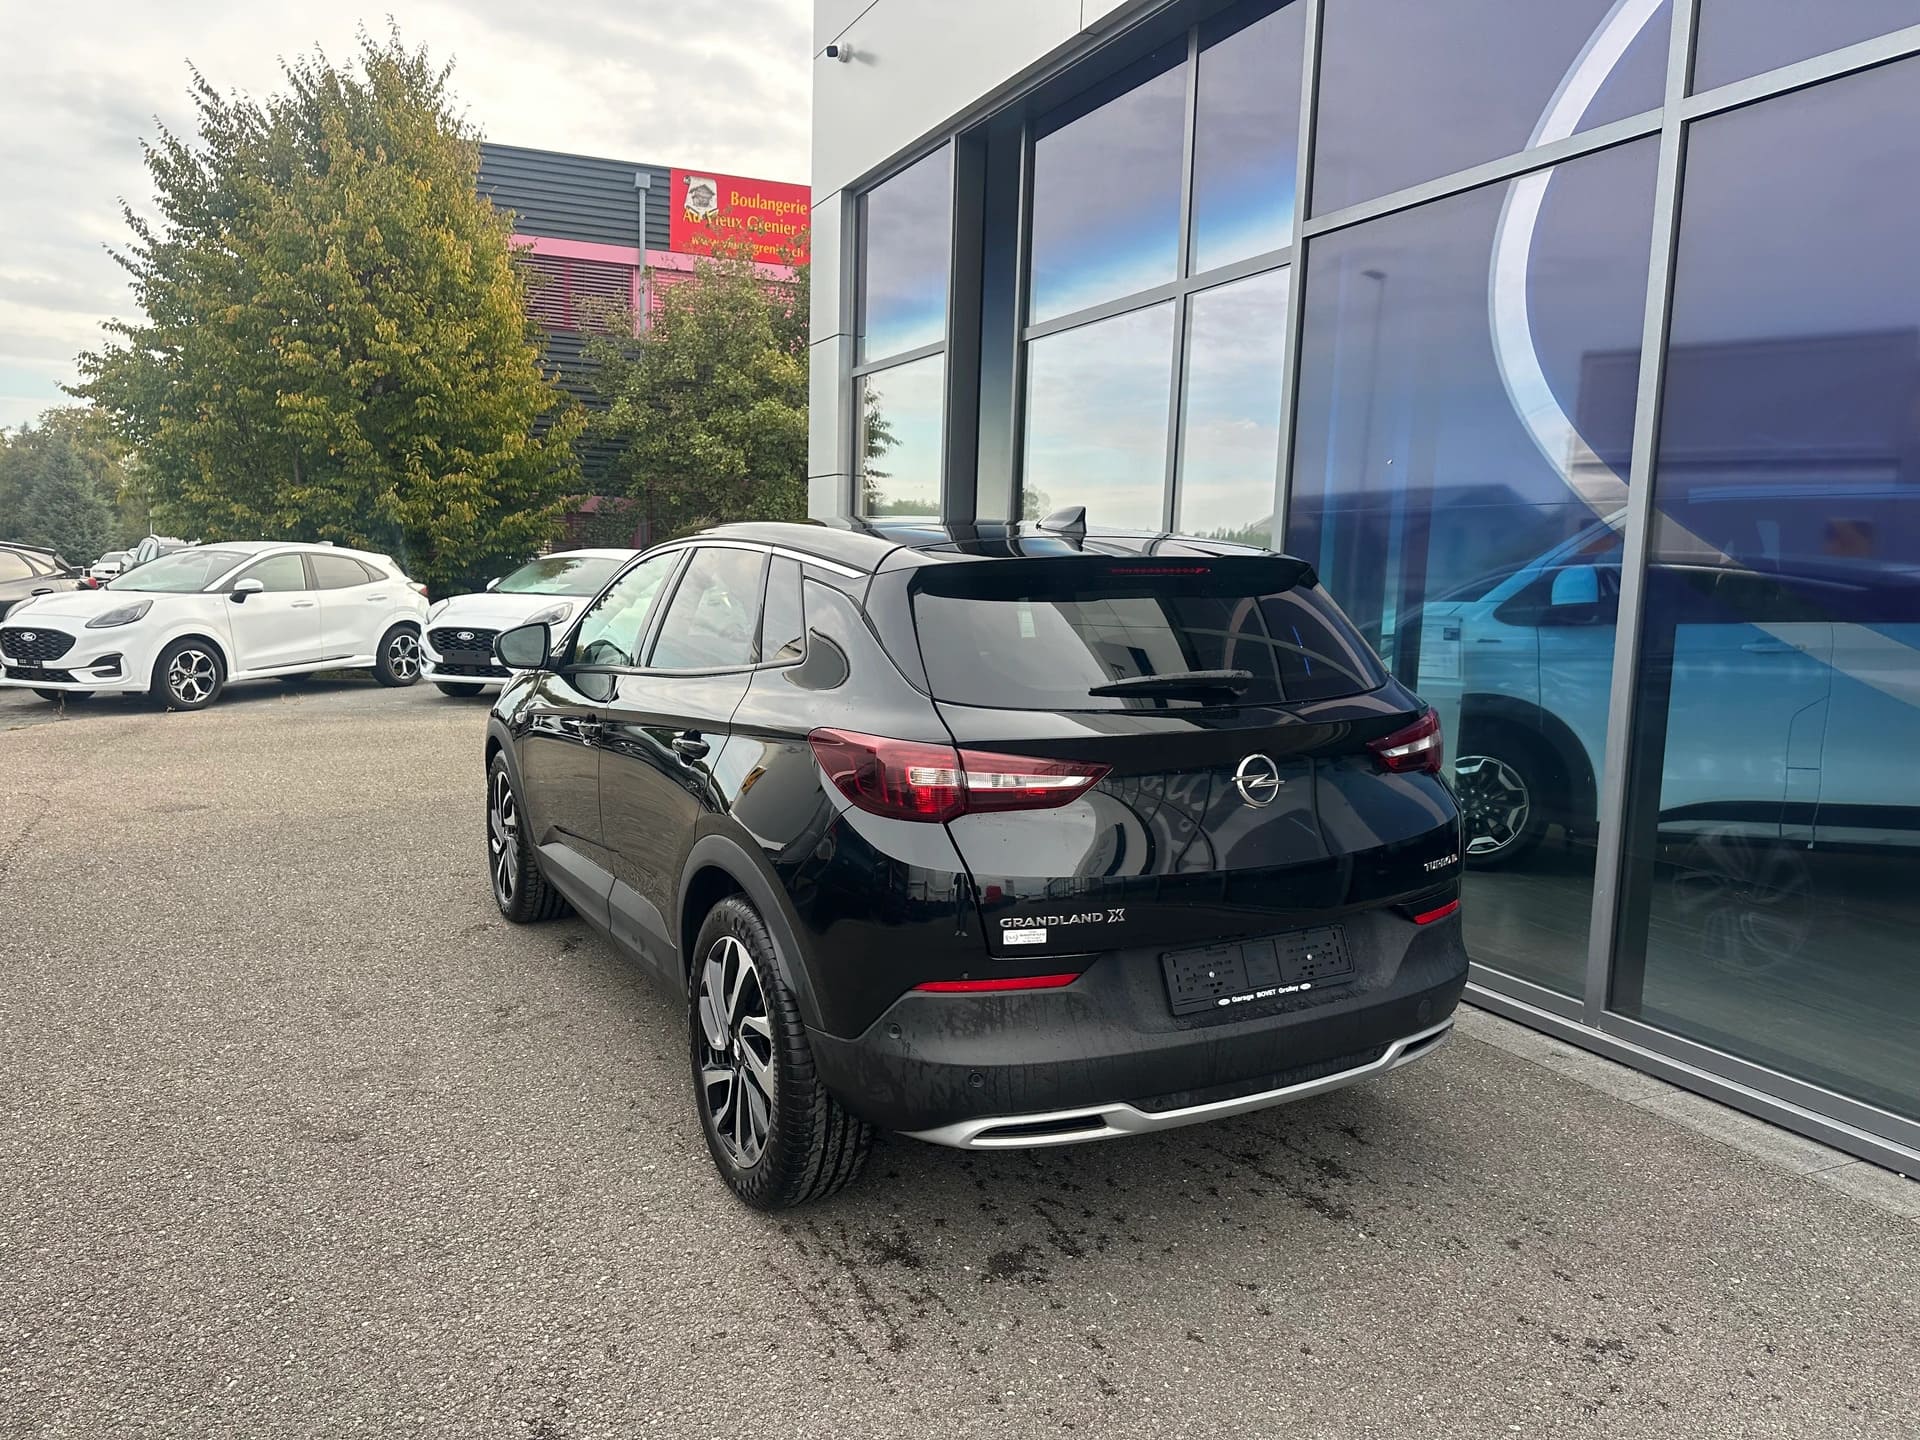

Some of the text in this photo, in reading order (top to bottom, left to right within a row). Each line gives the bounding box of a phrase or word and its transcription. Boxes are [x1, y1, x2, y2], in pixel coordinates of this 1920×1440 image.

[731, 191, 808, 216] Boulangerie
[1000, 908, 1126, 927] GRANDLAND X
[1232, 992, 1255, 1003] Garage
